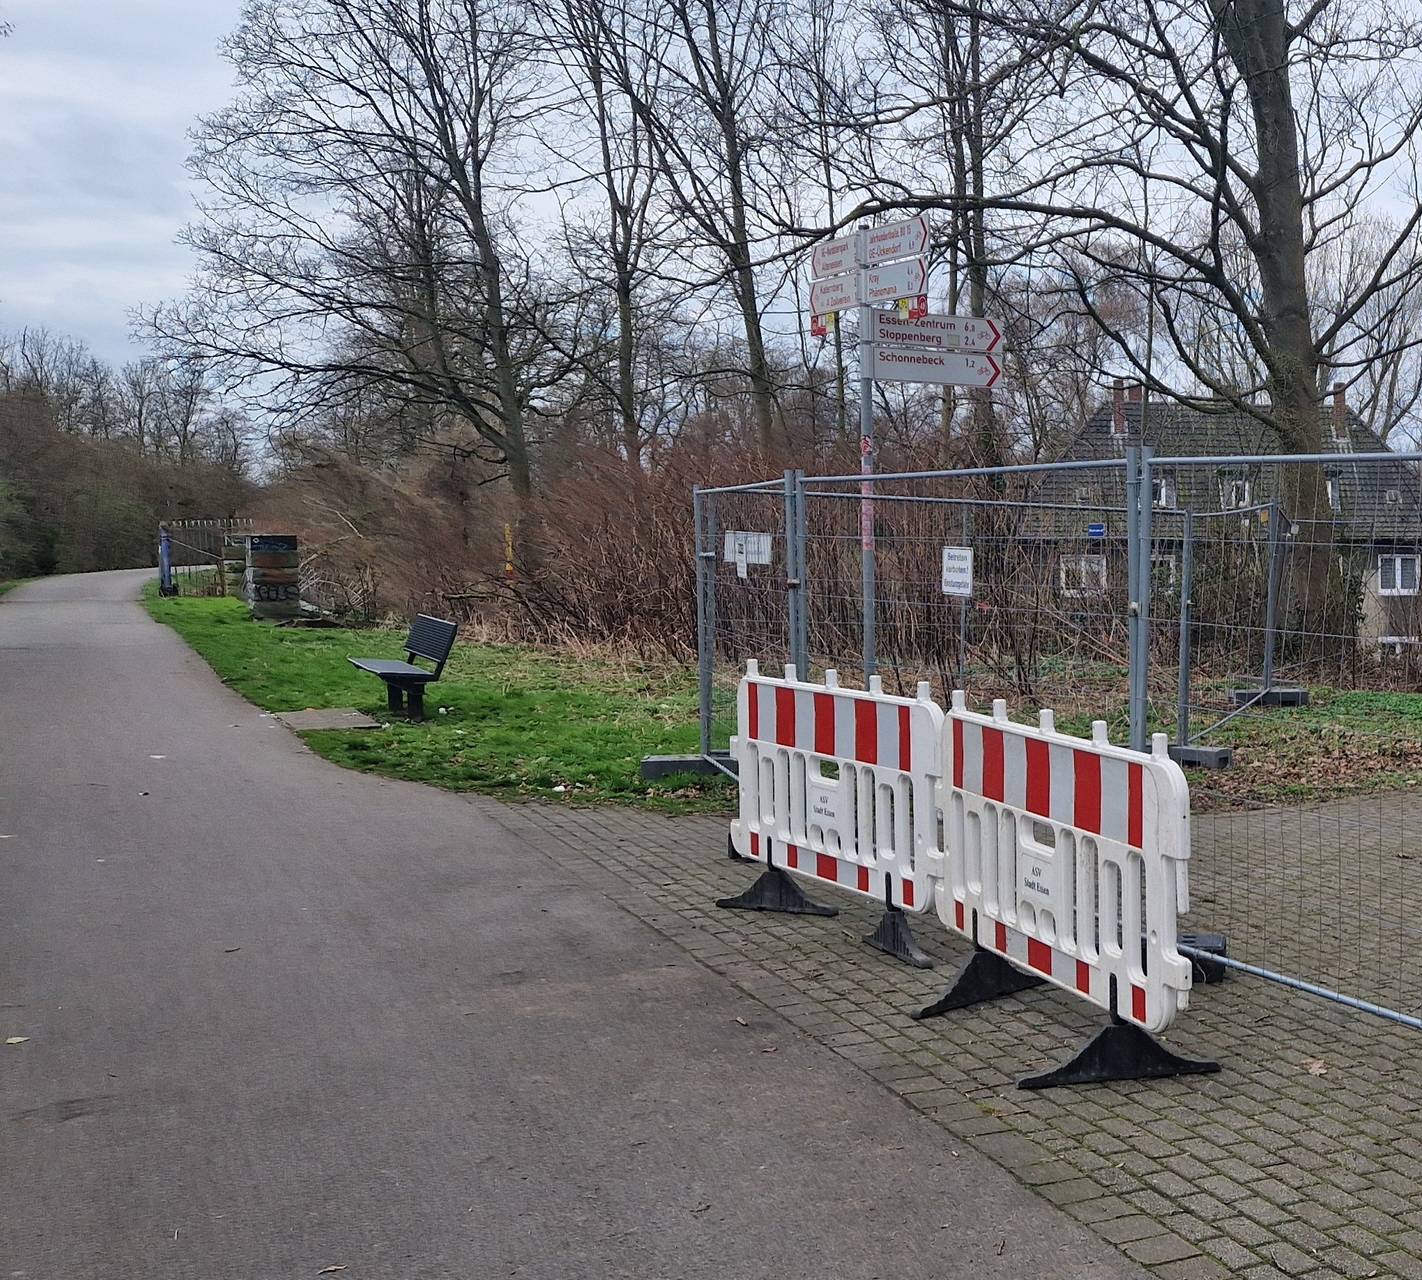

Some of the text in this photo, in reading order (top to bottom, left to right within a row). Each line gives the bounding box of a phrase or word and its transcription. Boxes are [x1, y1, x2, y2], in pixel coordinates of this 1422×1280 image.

[879, 314, 956, 330] Essen-Zentrum
[879, 328, 976, 346] Stoppenberg 2,4
[879, 351, 975, 368] Schonnebeck 1,2
